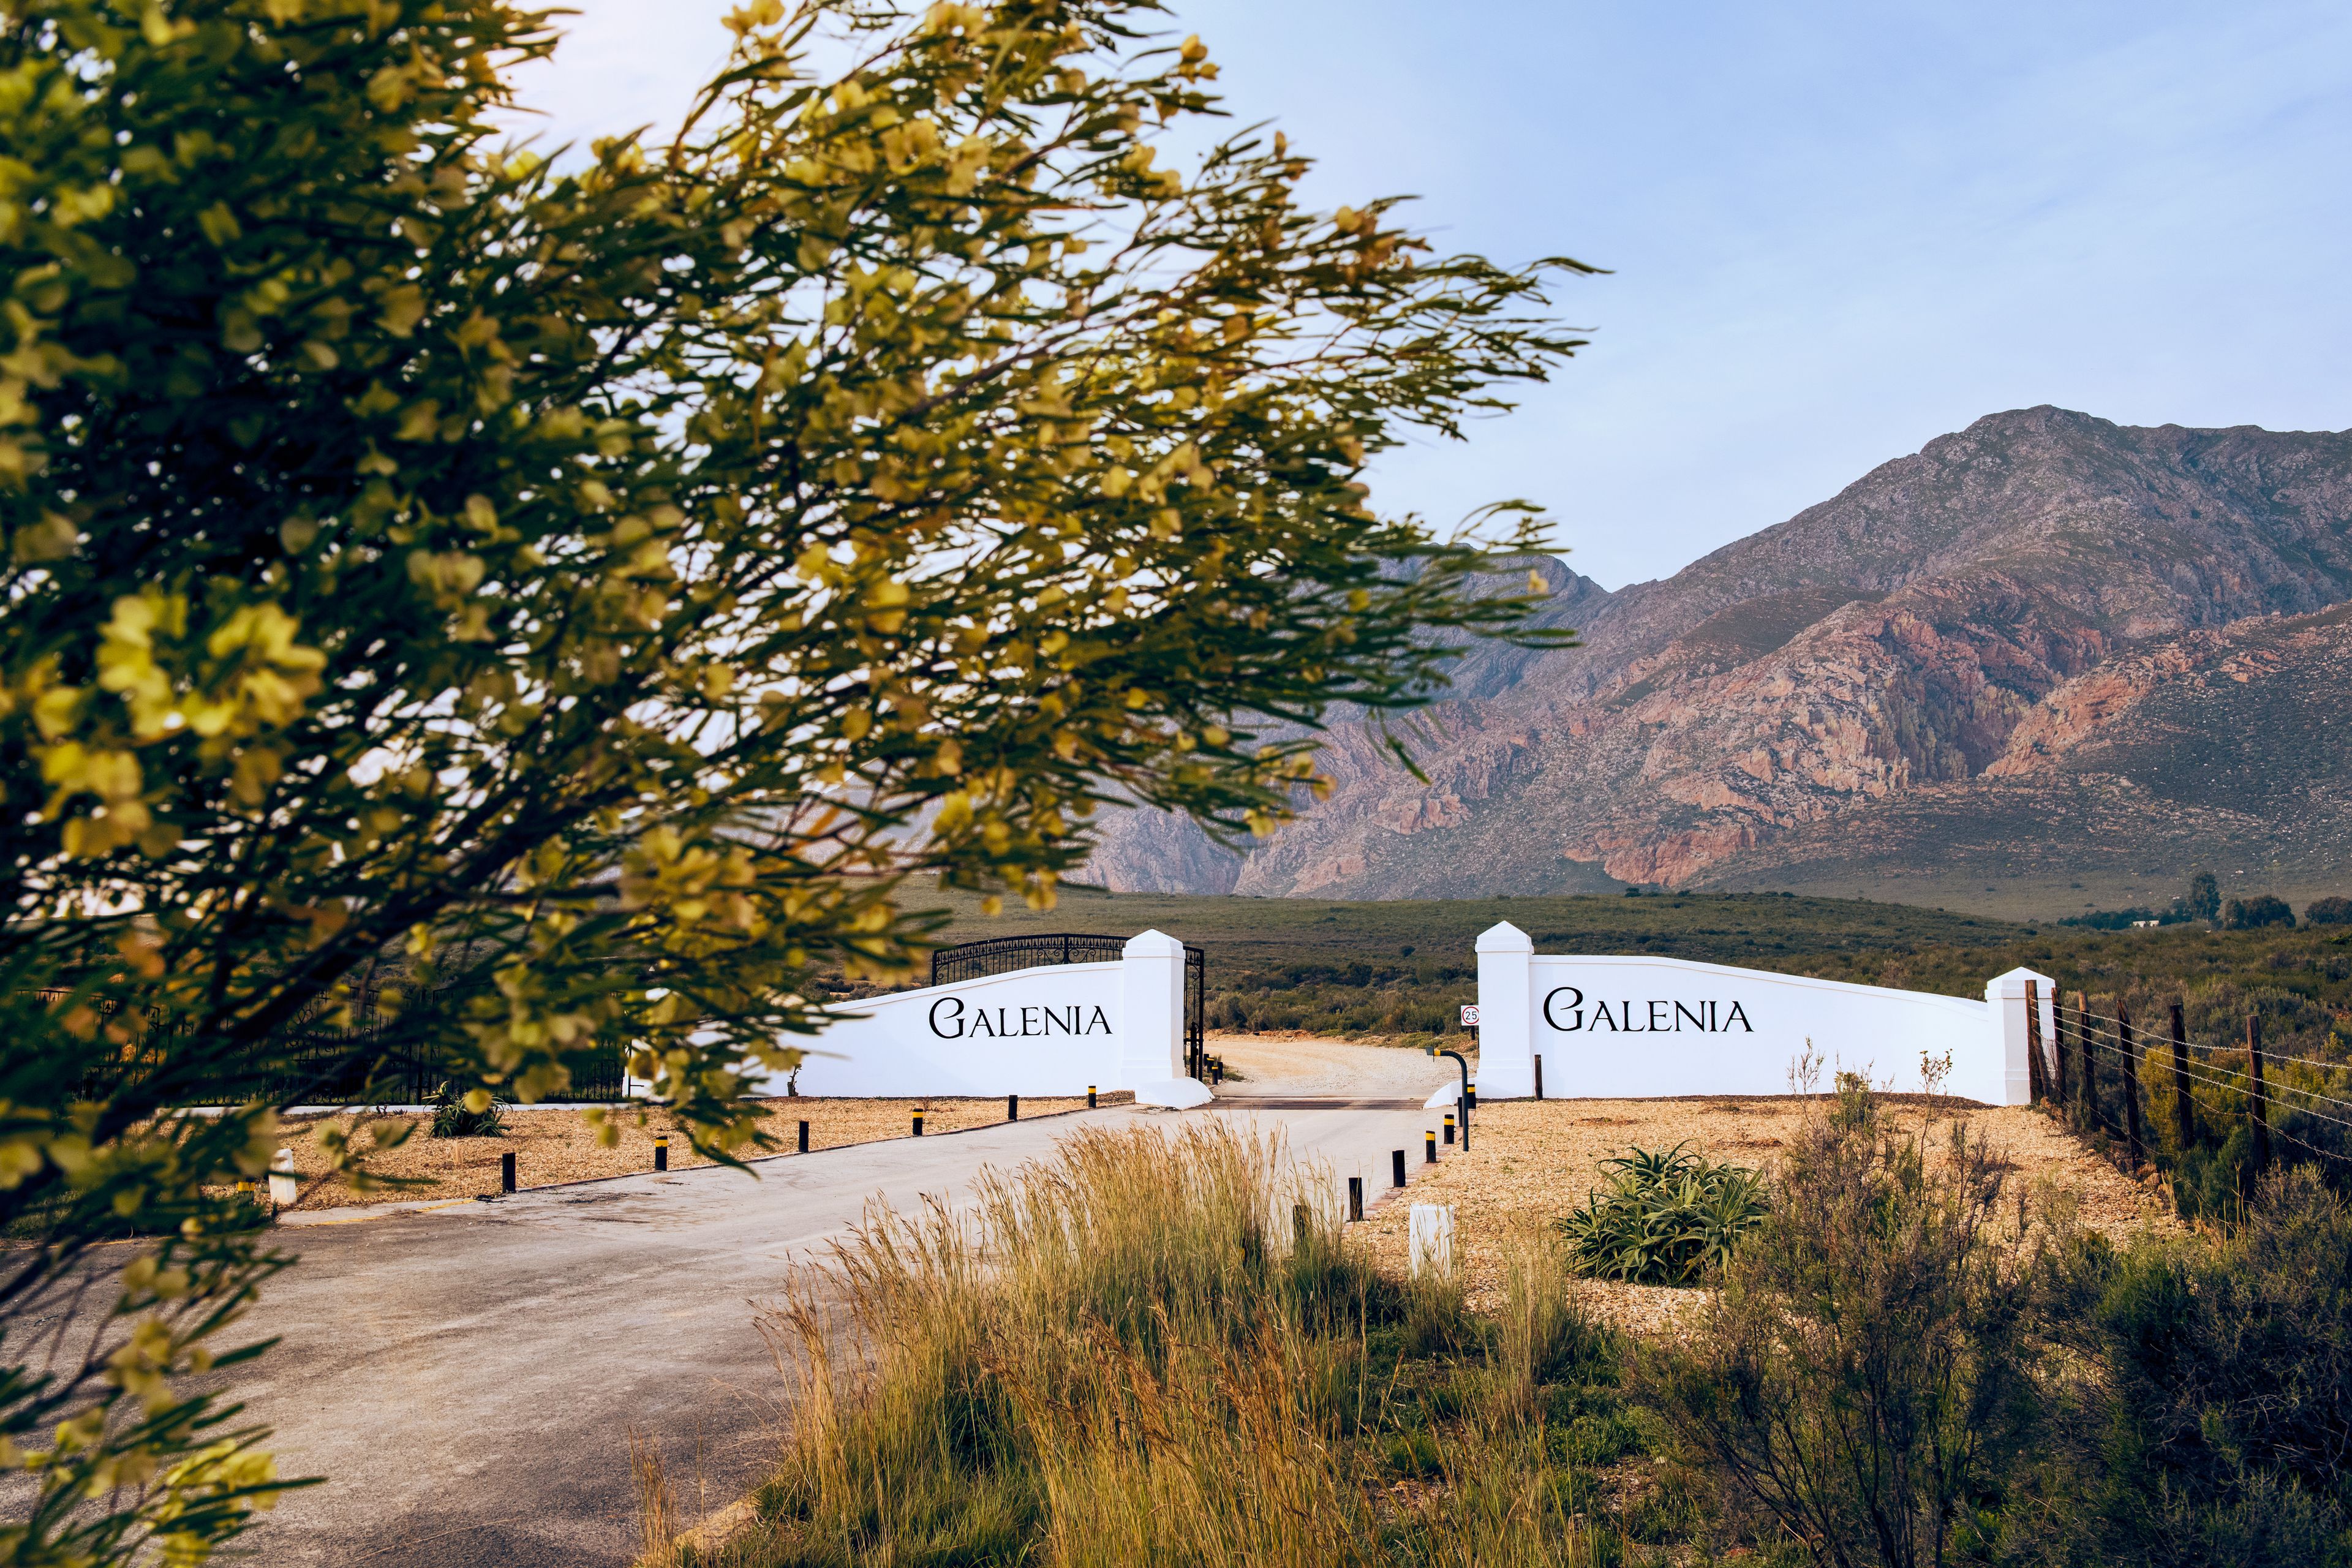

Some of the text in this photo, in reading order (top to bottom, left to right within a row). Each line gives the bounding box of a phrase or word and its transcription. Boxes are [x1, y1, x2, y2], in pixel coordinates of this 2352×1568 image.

[929, 997, 1114, 1039] GALENIA
[1465, 1011, 1477, 1020] 25
[1543, 986, 1755, 1033] GALENIA
